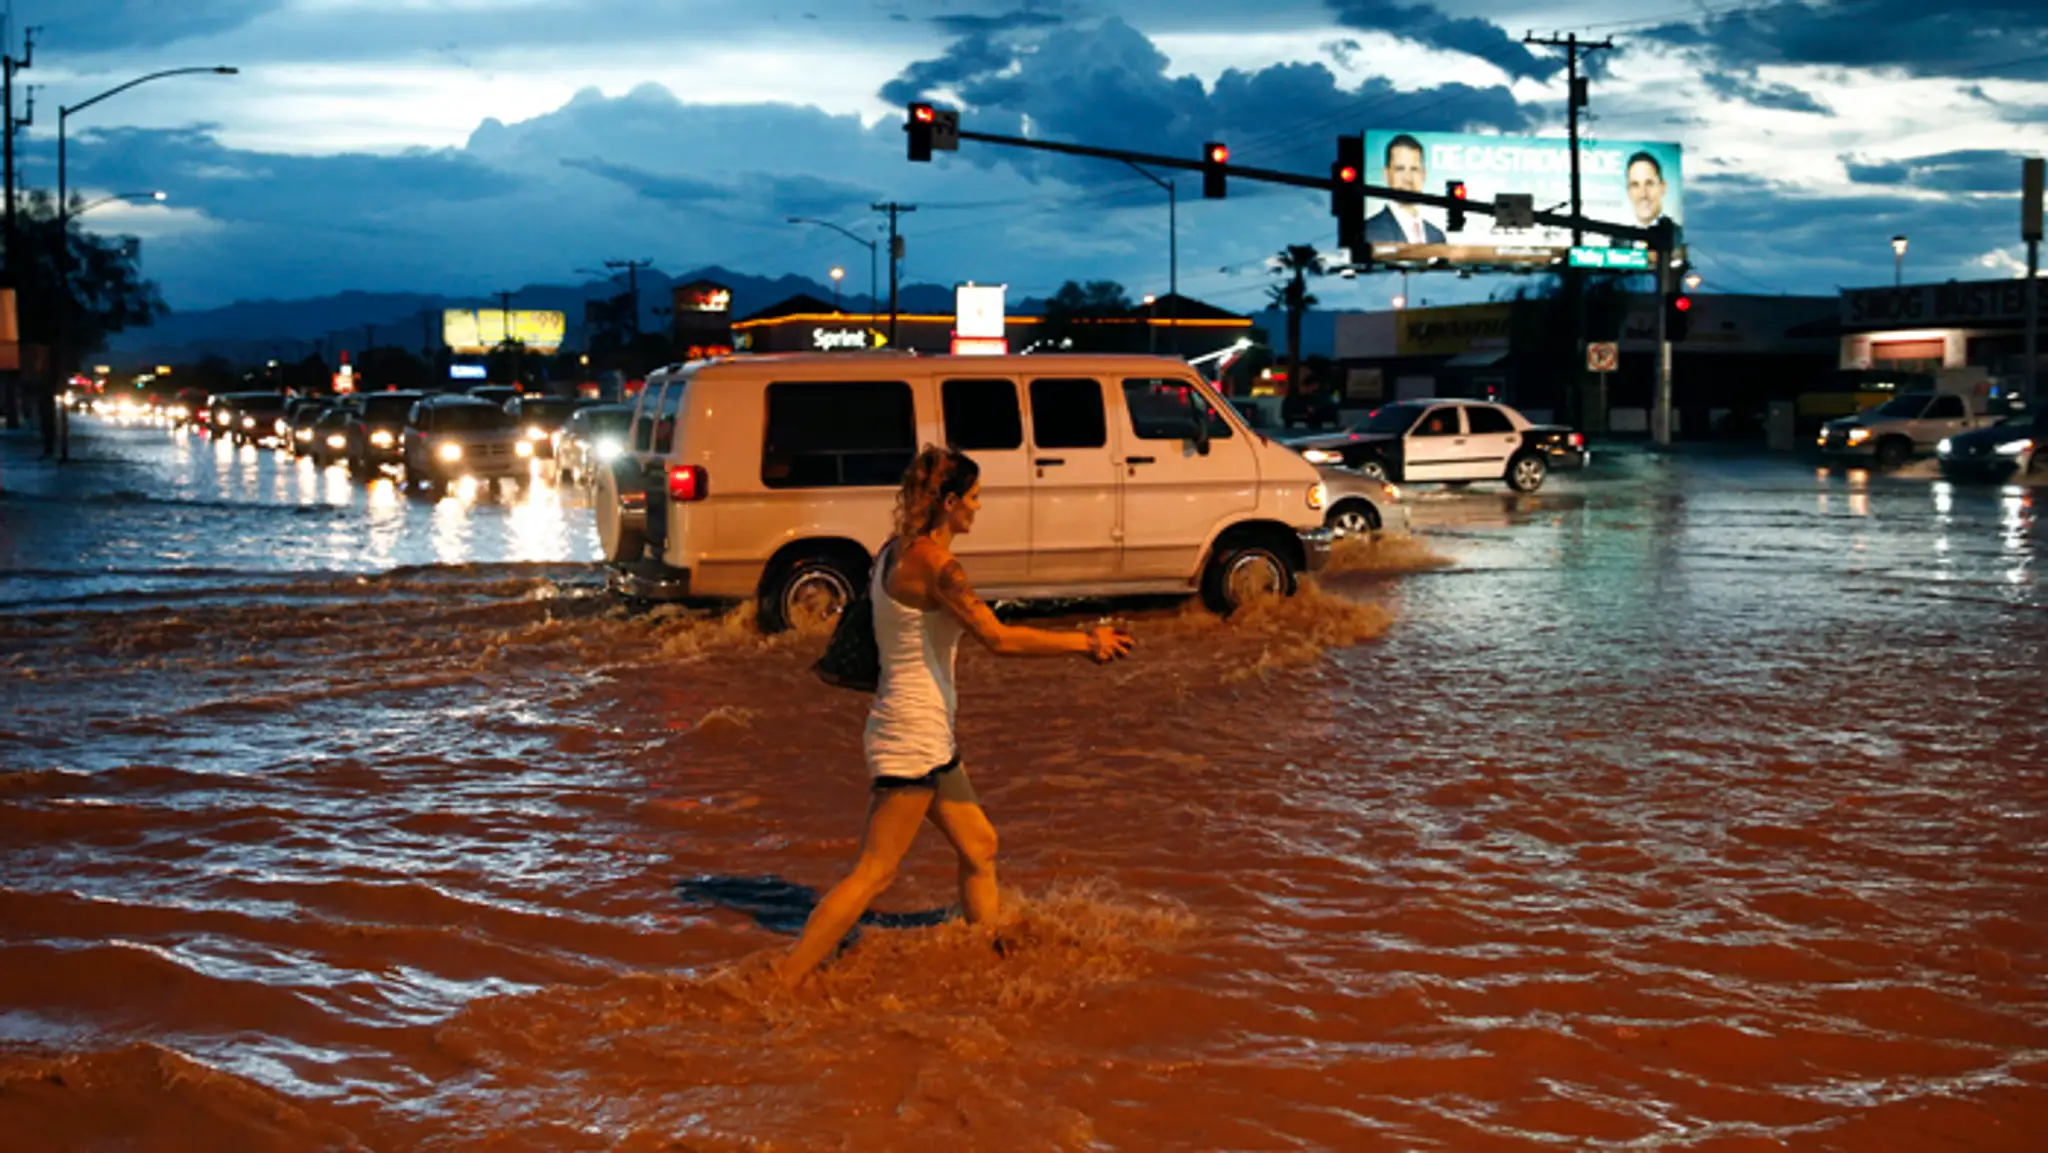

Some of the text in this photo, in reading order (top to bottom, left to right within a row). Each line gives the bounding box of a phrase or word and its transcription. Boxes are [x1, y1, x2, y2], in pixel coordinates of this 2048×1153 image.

[1431, 144, 1625, 174] DE CASTROVRDE
[812, 327, 867, 351] Sprint
